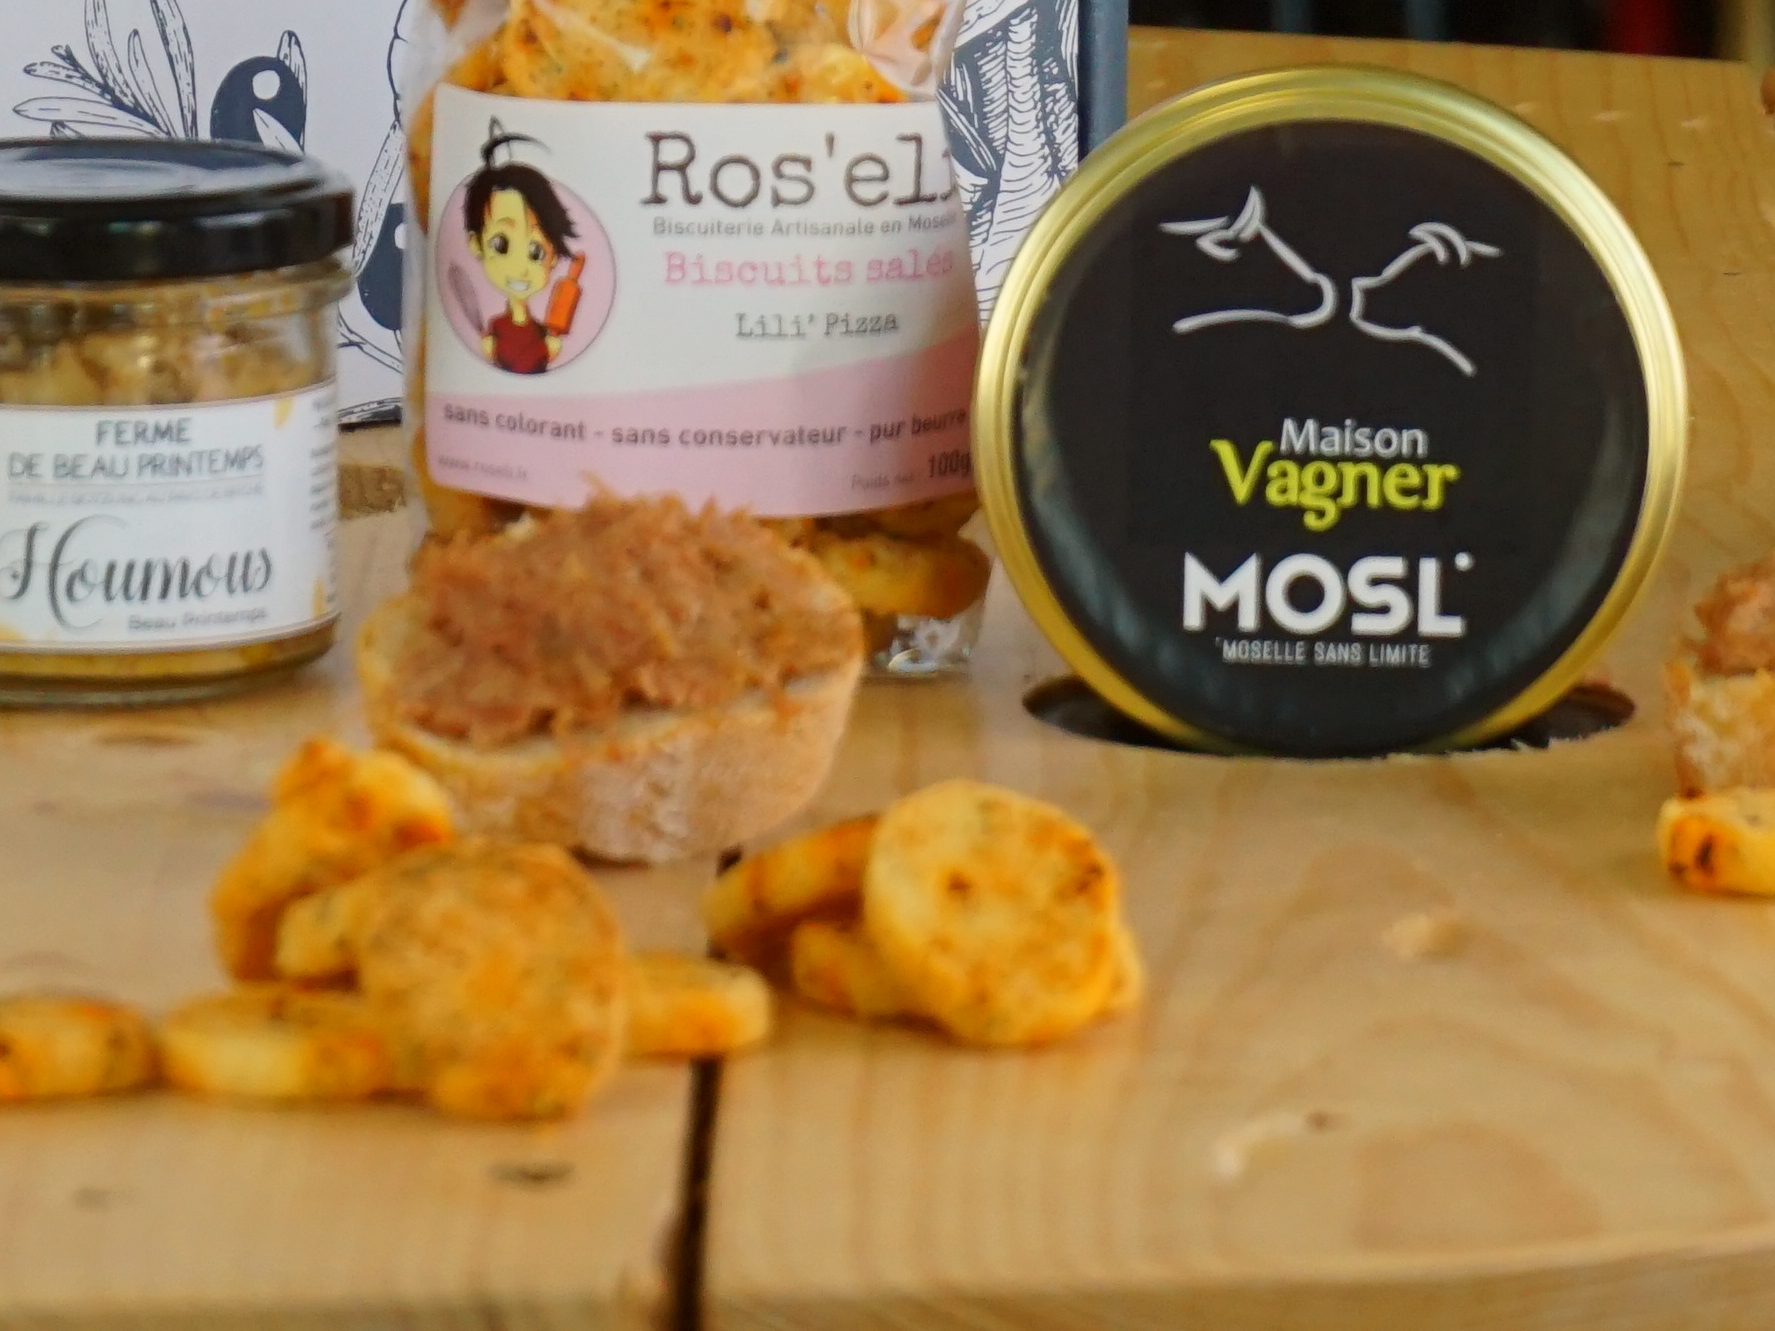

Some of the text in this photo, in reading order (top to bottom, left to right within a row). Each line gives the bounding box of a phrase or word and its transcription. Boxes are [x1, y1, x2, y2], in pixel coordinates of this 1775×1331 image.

[652, 215, 764, 236] Biscuiterie
[770, 216, 875, 236] Artisanale
[880, 219, 902, 236] en
[662, 242, 955, 285] Biscuits salés
[824, 310, 900, 336] Pizza
[94, 417, 193, 446] FERME
[443, 402, 490, 426] sans
[494, 411, 586, 441] colorant
[610, 425, 671, 446] sans
[677, 421, 847, 448] conservateur
[869, 418, 907, 448] pur
[910, 407, 968, 436] beurre
[1278, 416, 1429, 459] Maison
[7, 443, 264, 480] DE BEAU PRINTEMPS
[1208, 438, 1462, 533] Vagner
[1313, 640, 1362, 666] SANS
[1368, 642, 1431, 668] LIMITE
